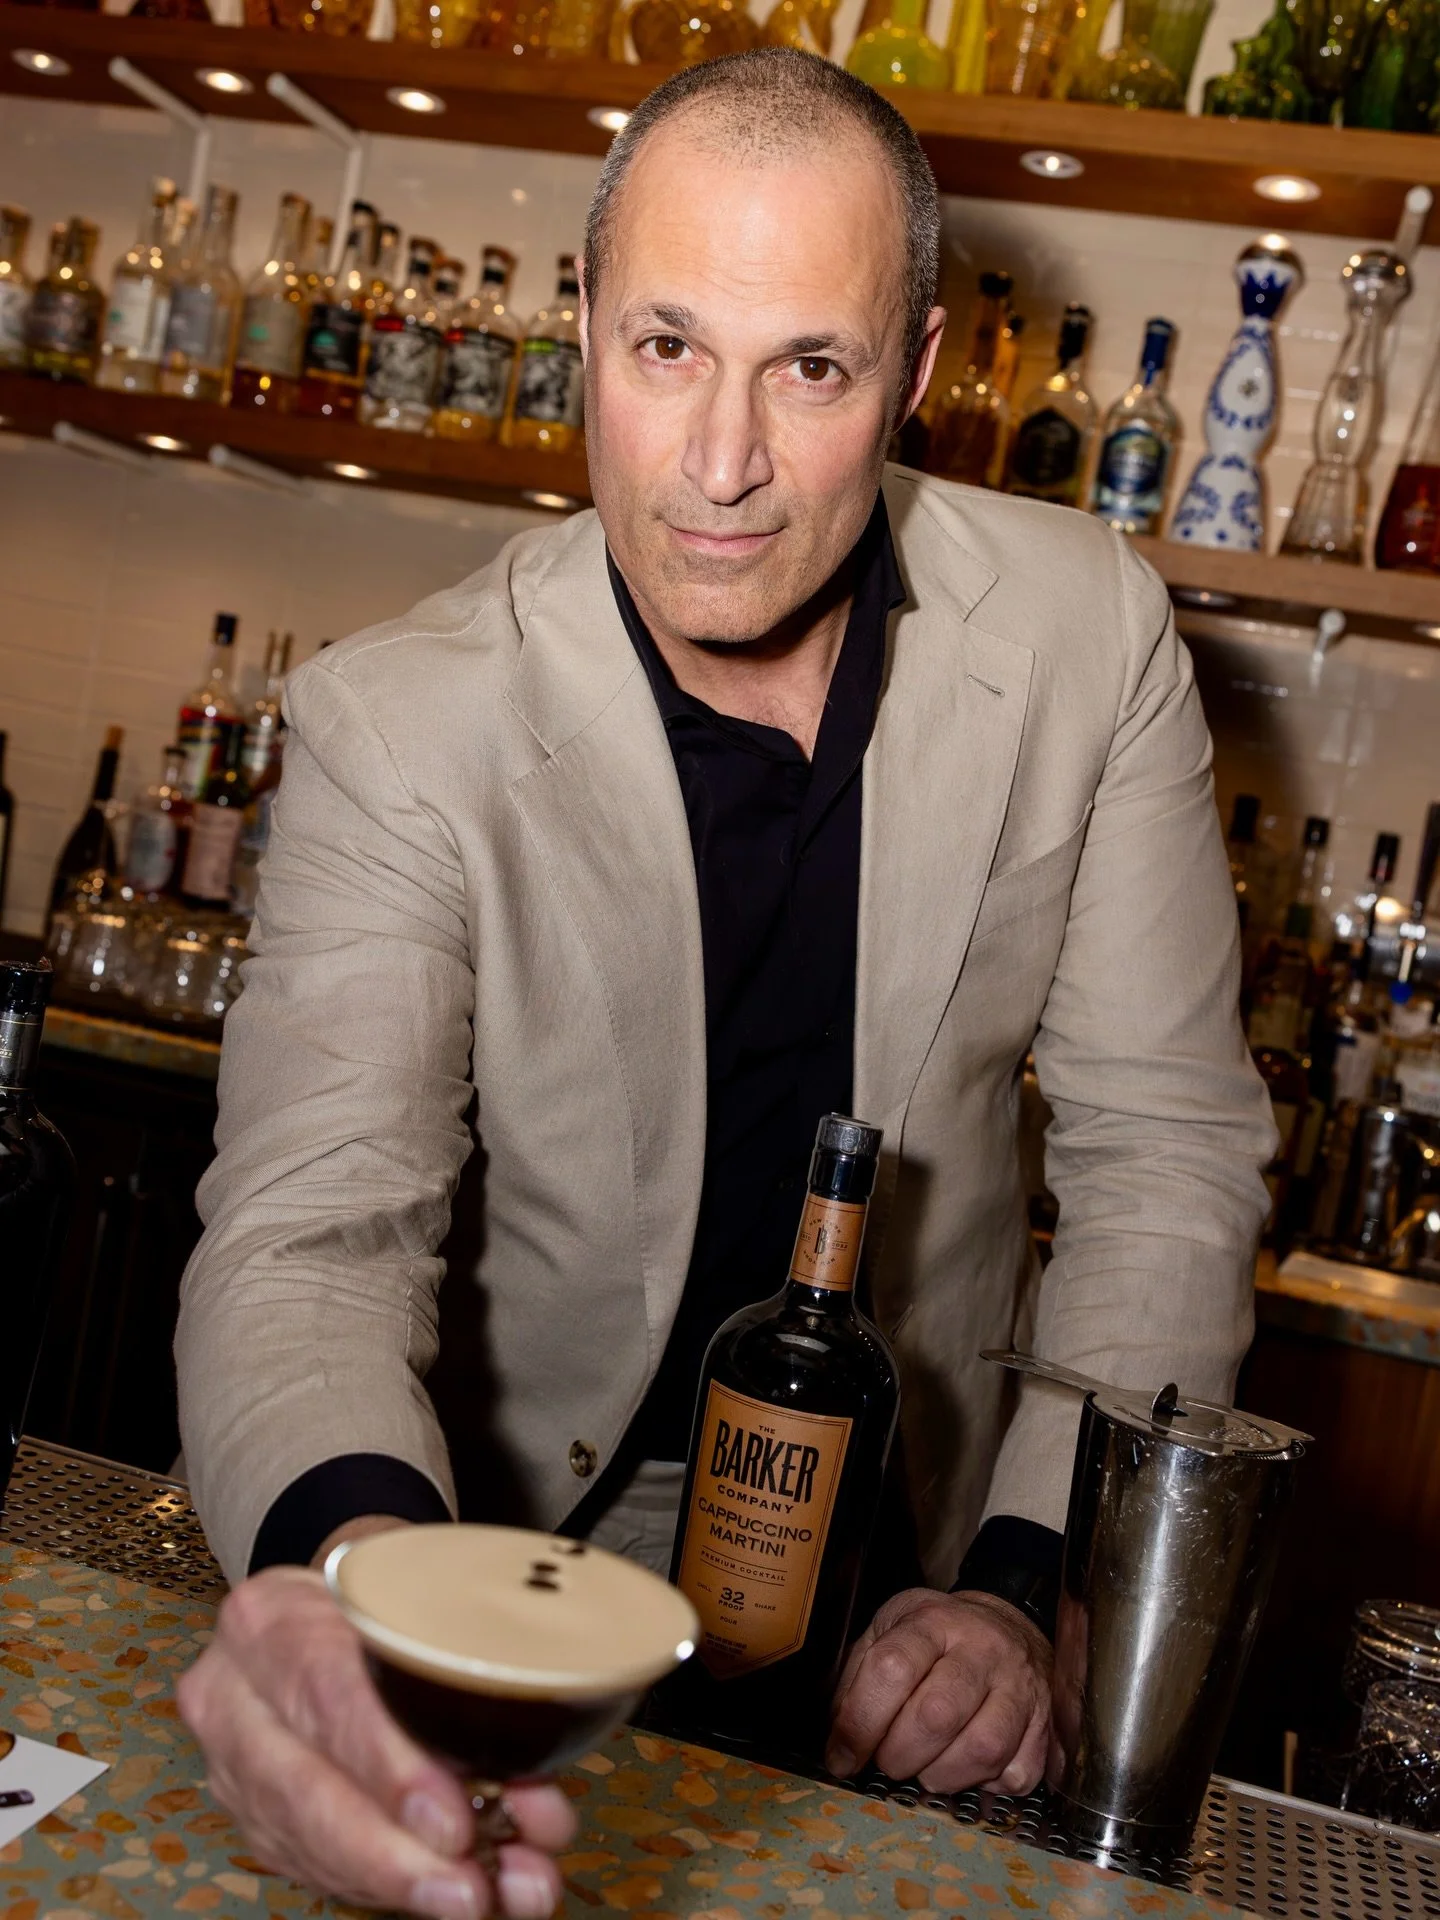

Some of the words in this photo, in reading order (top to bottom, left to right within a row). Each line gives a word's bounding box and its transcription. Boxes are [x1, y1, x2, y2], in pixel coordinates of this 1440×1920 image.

[759, 1424, 776, 1435] THE
[710, 1418, 820, 1504] BARKER
[717, 1484, 795, 1514] COMPANY
[698, 1496, 813, 1543] CAPPUCCINO
[709, 1522, 787, 1558] MARTINI
[701, 1550, 736, 1569] PREMIUM
[740, 1566, 786, 1582] COCKTAIL
[718, 1599, 745, 1612] PROOF
[720, 1587, 745, 1606] 32
[754, 1602, 777, 1611] SHAKE
[720, 1615, 738, 1626] POUR
